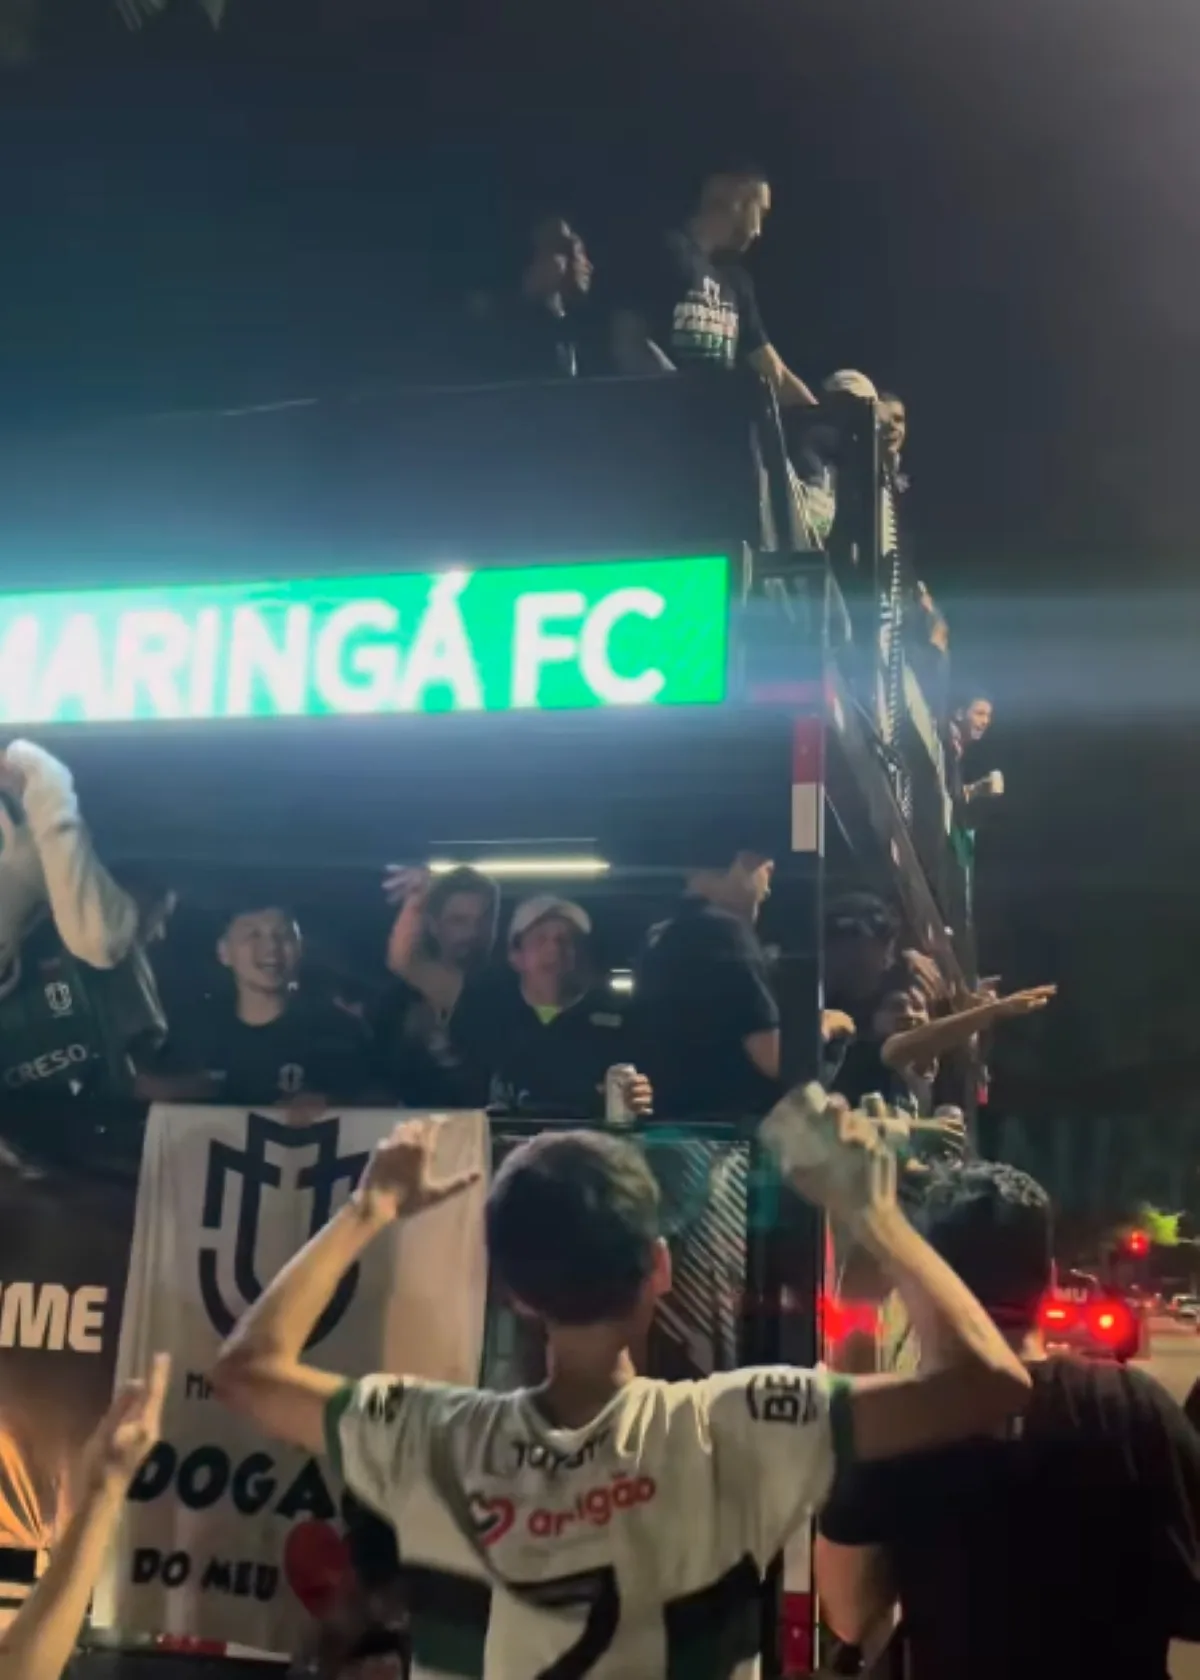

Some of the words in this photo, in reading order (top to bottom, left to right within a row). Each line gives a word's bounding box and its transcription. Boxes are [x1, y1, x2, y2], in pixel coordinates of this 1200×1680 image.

[508, 588, 667, 706] FC
[130, 1441, 336, 1519] DOGA
[526, 1470, 657, 1533] arigão
[132, 1548, 192, 1588] DO
[201, 1555, 280, 1602] MEU
